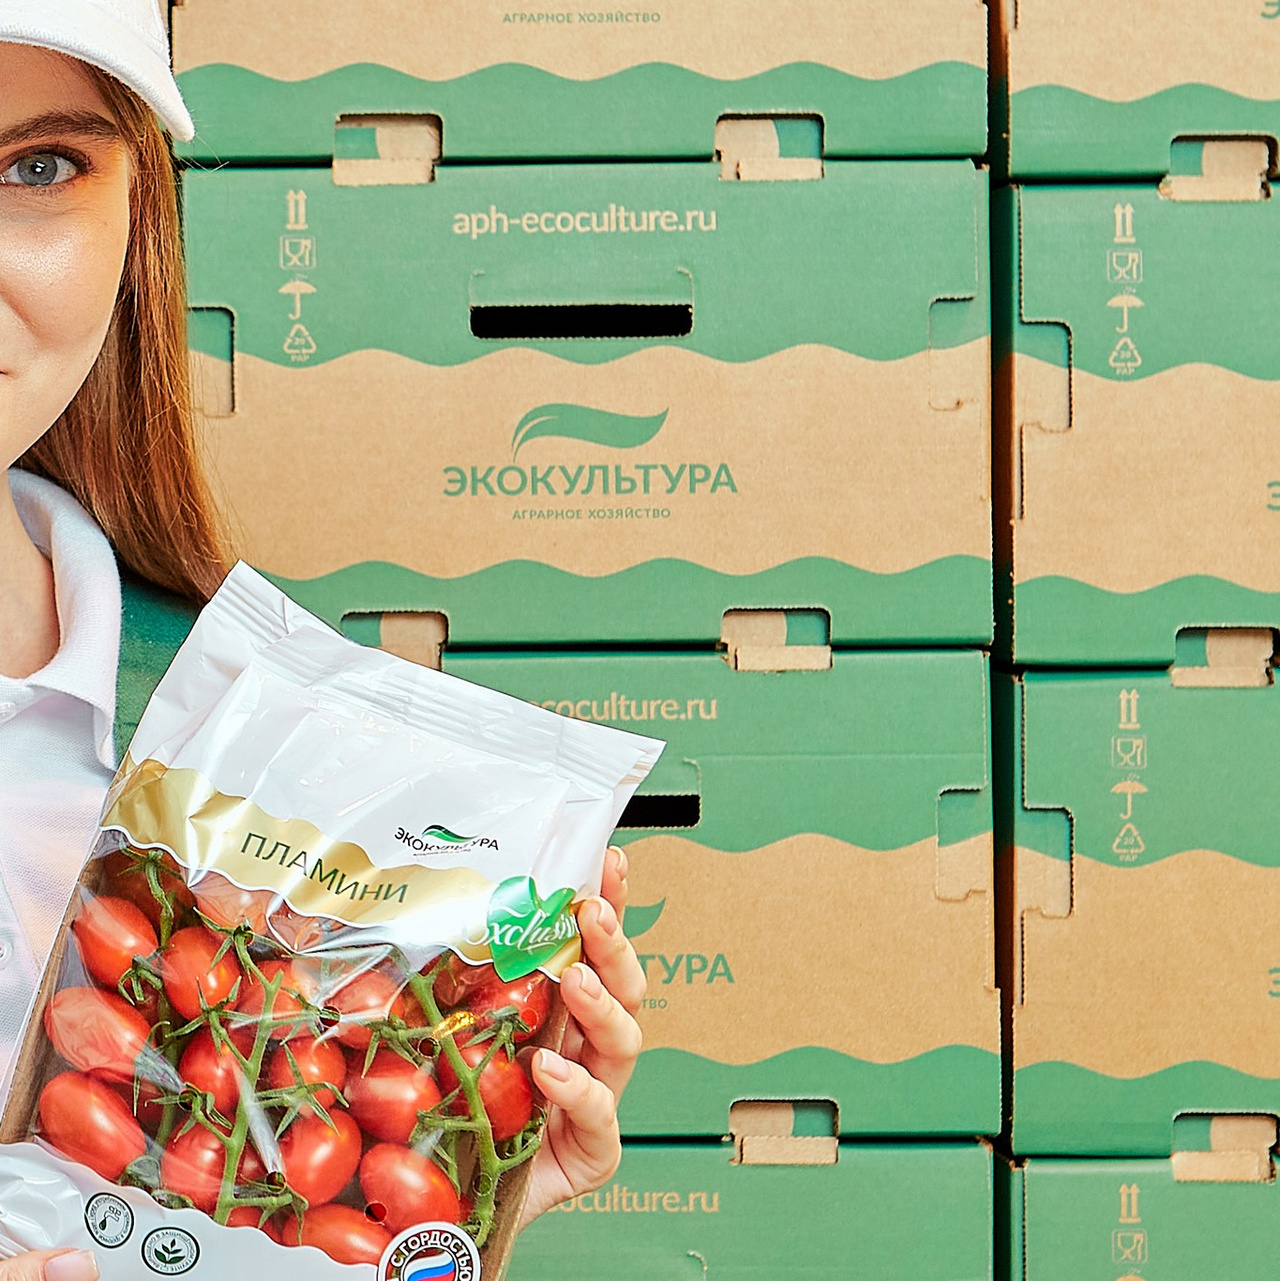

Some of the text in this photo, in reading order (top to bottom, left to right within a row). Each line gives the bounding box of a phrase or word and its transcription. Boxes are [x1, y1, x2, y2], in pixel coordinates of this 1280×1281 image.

[501, 12, 661, 24] АГРАРНОЕ ХОЗЯЙСТВО
[453, 204, 716, 239] aph-ecoculture.ru
[444, 463, 737, 497] ЭКОКУЛЬТУРА
[511, 508, 672, 520] АГРАРНОЕ ХОЗЯЙСТВО
[1124, 837, 1134, 845] 20
[239, 832, 409, 904] ПЛАМИНИ
[390, 1254, 404, 1268] С
